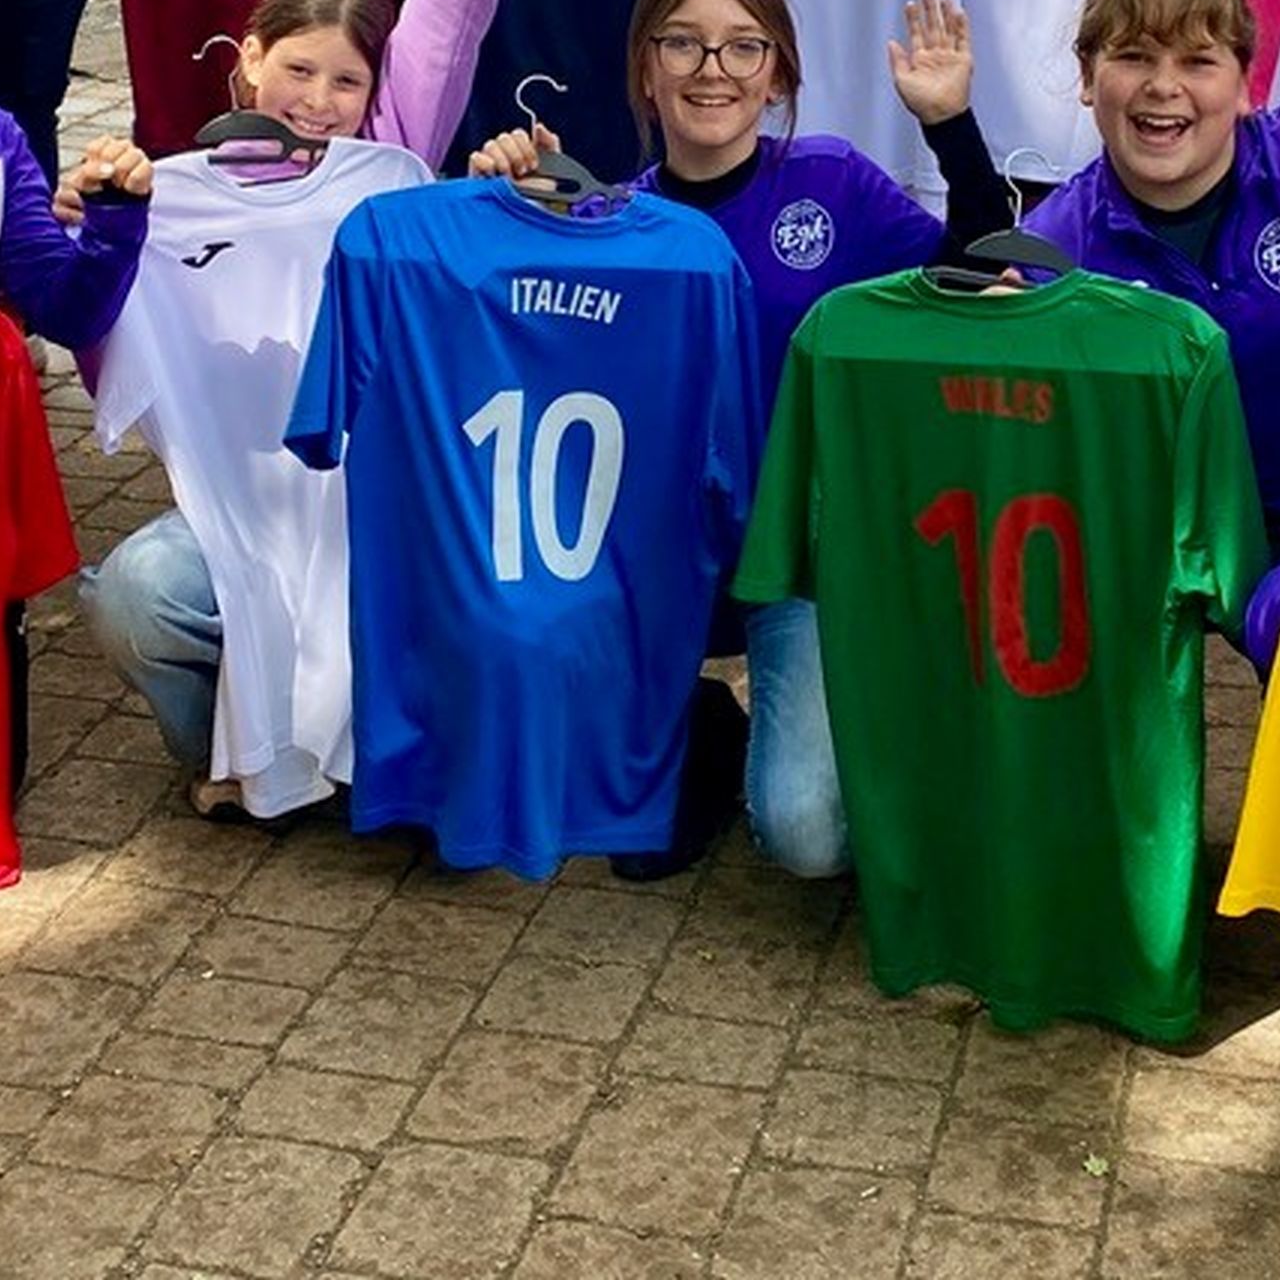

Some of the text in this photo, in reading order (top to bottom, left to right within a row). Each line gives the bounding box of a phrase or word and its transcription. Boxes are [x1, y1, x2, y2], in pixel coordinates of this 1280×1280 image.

[511, 278, 621, 324] ITALIEN
[462, 390, 625, 581] 10
[914, 489, 1092, 698] 10
